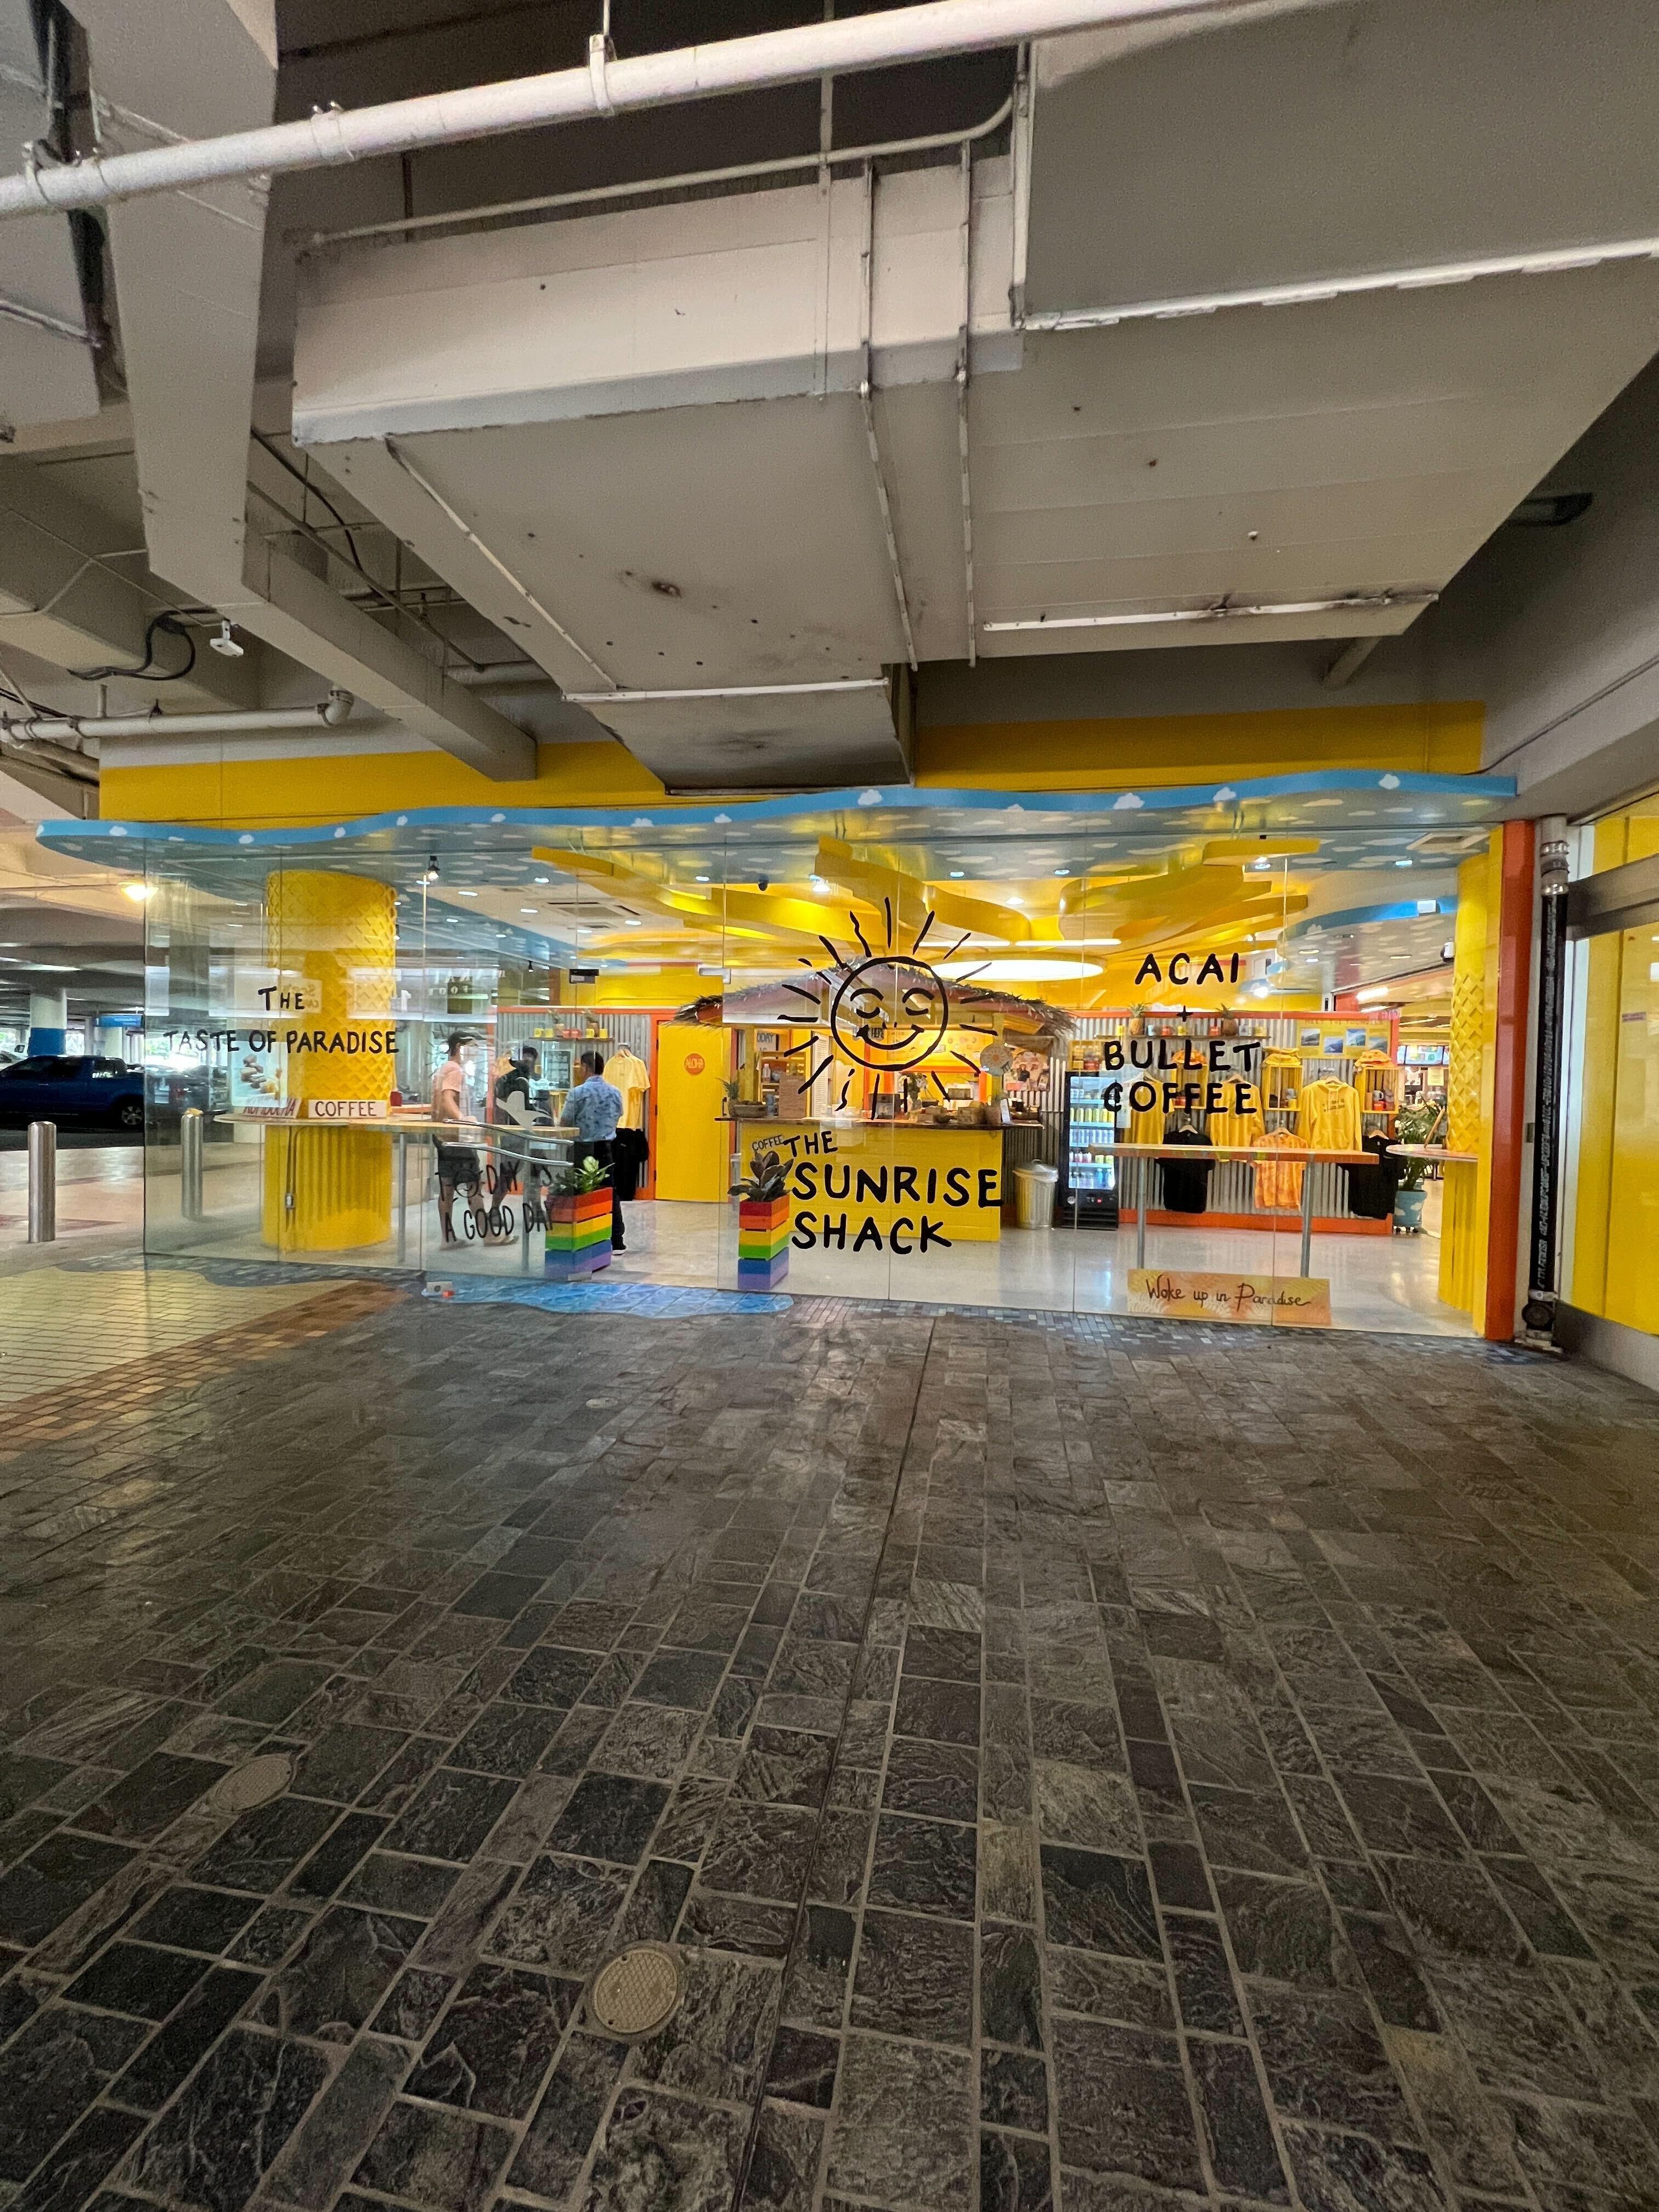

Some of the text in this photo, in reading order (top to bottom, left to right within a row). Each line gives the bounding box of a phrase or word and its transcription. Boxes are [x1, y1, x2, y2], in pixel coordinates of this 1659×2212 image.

[1135, 952, 1239, 985] ACAI
[258, 986, 305, 1011] THE
[163, 1029, 400, 1054] TASTE OF PARADISE
[1104, 1039, 1261, 1072] BULLET
[315, 1101, 377, 1116] COFFEE
[1104, 1081, 1257, 1115] COFFEE
[752, 1135, 785, 1152] COFFEE
[782, 1131, 838, 1157] THE
[792, 1162, 1003, 1208] SUNRISE
[445, 1212, 457, 1242] A
[464, 1205, 515, 1240] GOOD
[791, 1211, 952, 1255] SHACK
[1194, 1293, 1208, 1308] up
[1216, 1290, 1231, 1302] in
[1234, 1283, 1311, 1312] Paradise
